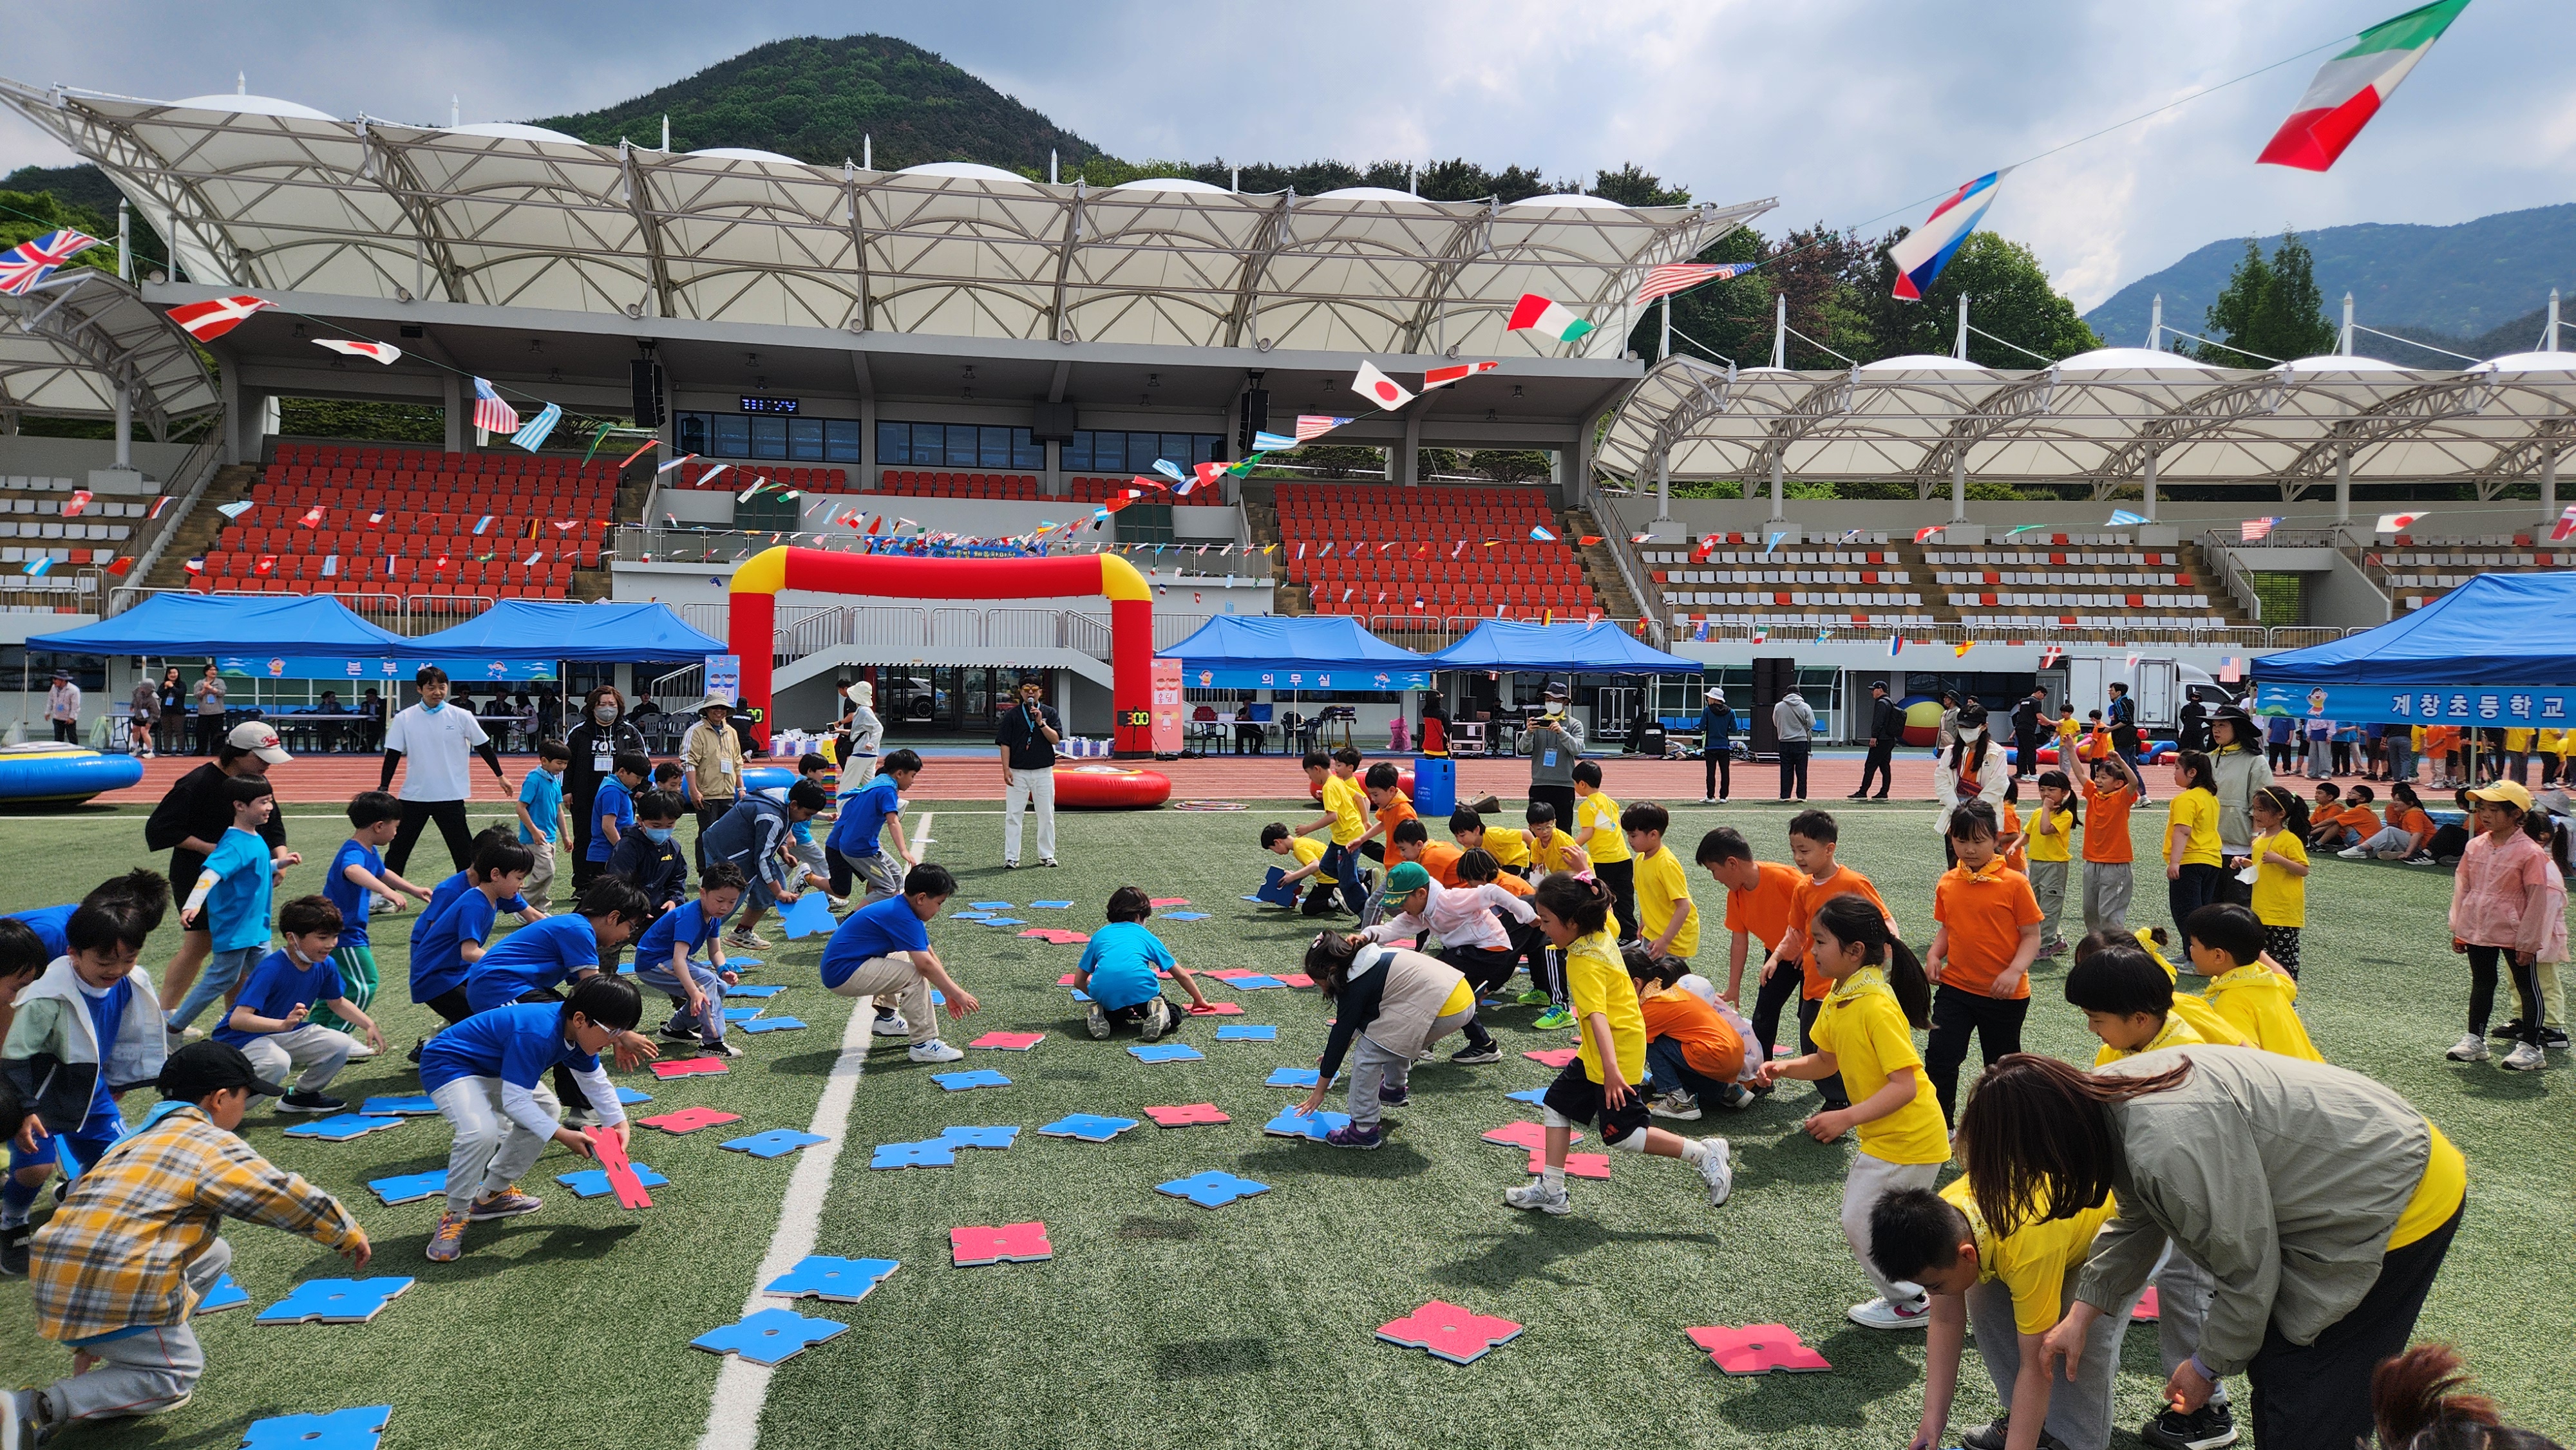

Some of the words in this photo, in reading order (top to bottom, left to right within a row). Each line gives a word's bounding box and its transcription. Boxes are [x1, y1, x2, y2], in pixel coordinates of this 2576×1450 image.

[2391, 693, 2566, 720] 계창초등학교
[896, 1020, 905, 1028] N
[929, 1044, 941, 1052] N
